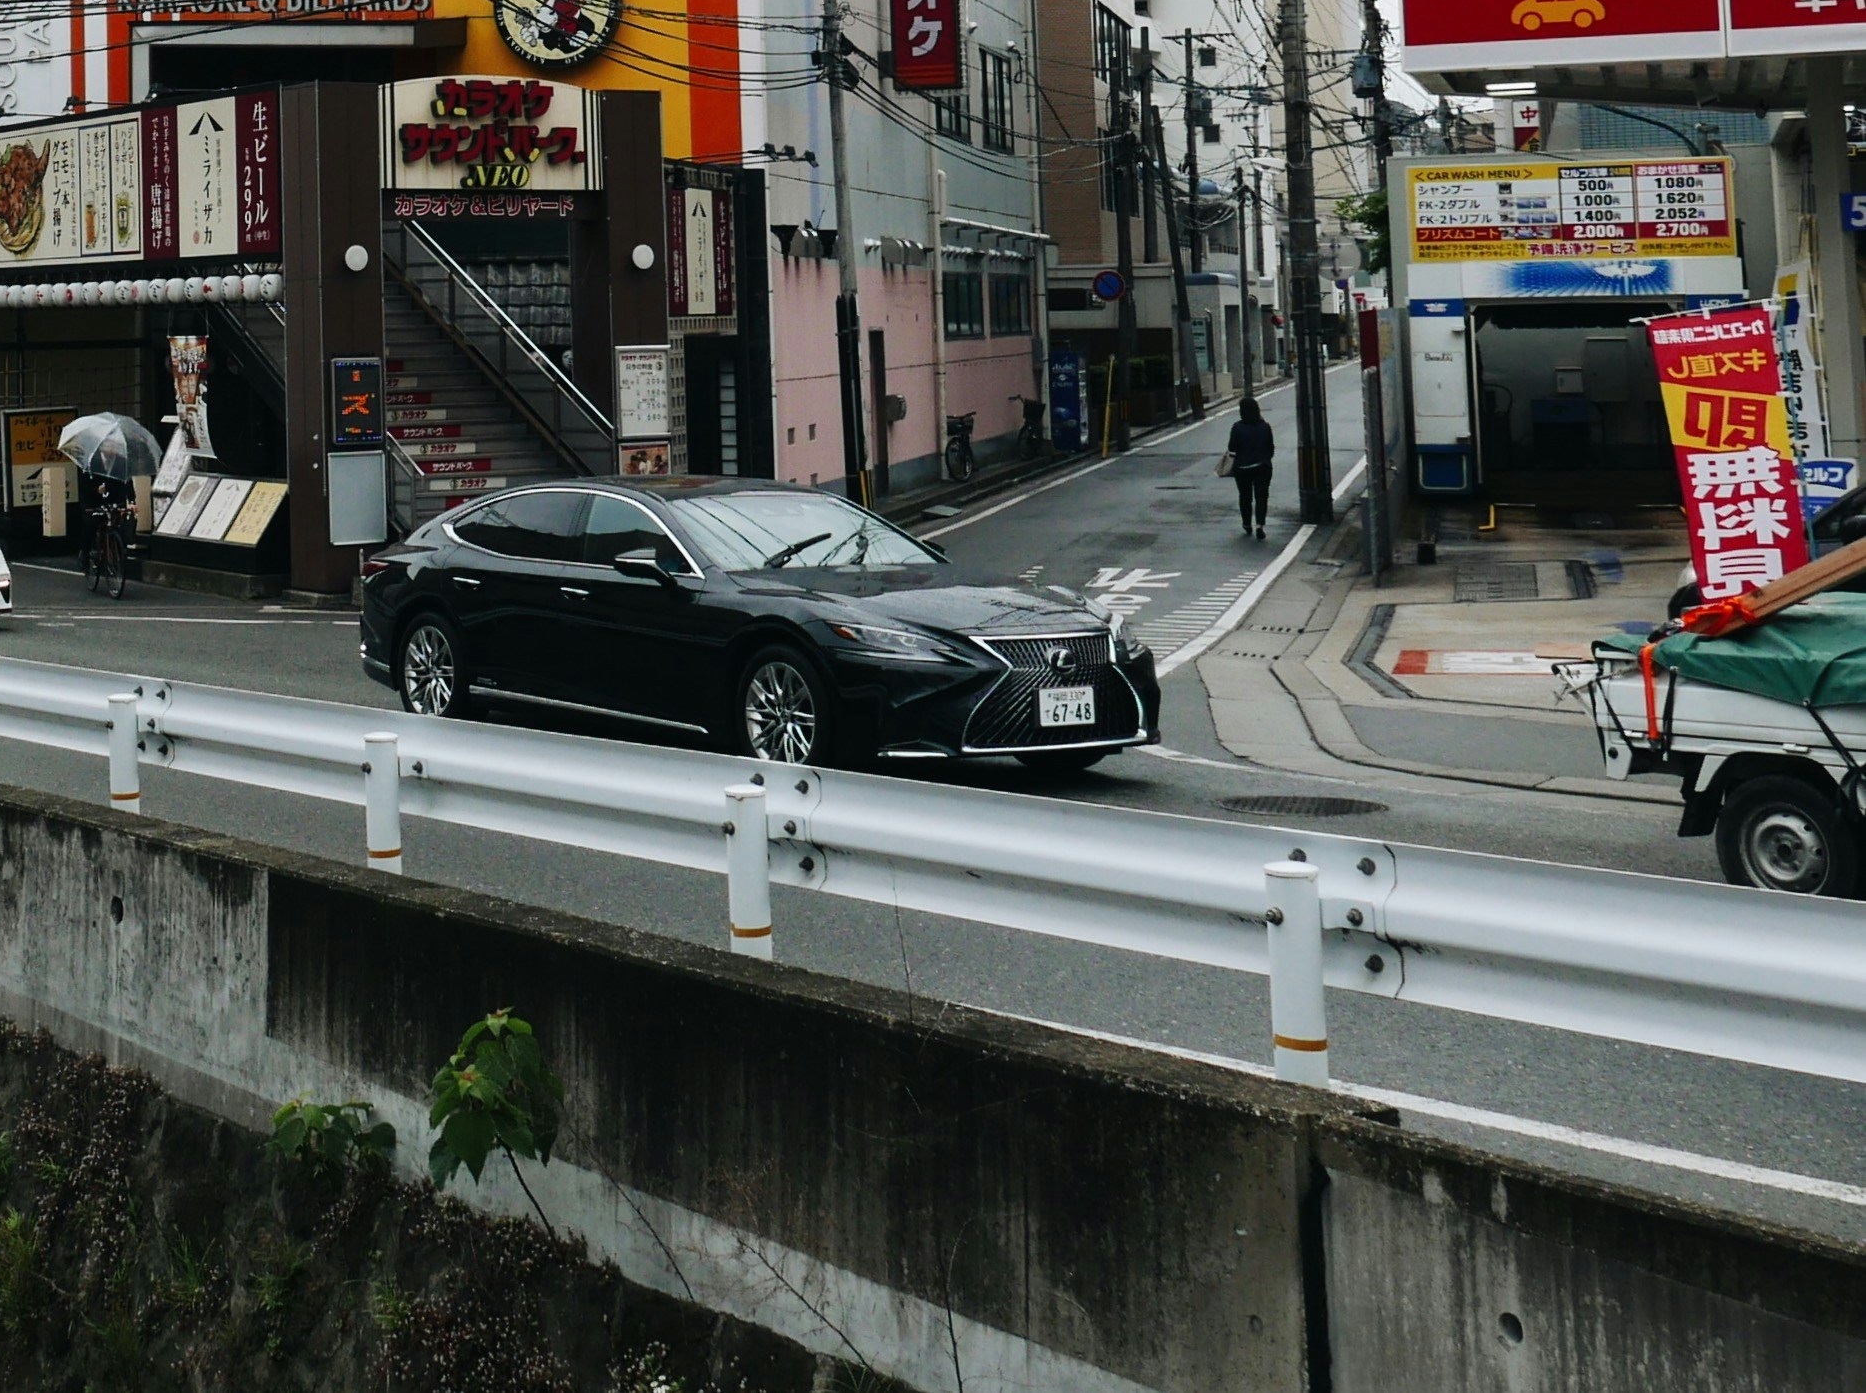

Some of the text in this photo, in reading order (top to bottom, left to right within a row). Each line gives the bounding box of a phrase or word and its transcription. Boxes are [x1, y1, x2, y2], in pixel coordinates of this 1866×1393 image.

[432, 79, 554, 118] カラオケ
[252, 101, 269, 225] 生ビール
[61, 141, 70, 209] モモ一本
[1427, 169, 1521, 181] CAR WASH MENU
[203, 135, 212, 245] ミライザカ
[1418, 184, 1474, 195] シャンプー
[395, 194, 574, 217] カラオケ&ビリヤード
[400, 410, 428, 420] カラオケ
[16, 439, 54, 452] 生ビール
[430, 443, 457, 454] カラオケ
[460, 478, 488, 488] カラオケ
[1052, 702, 1092, 723] 67-48
